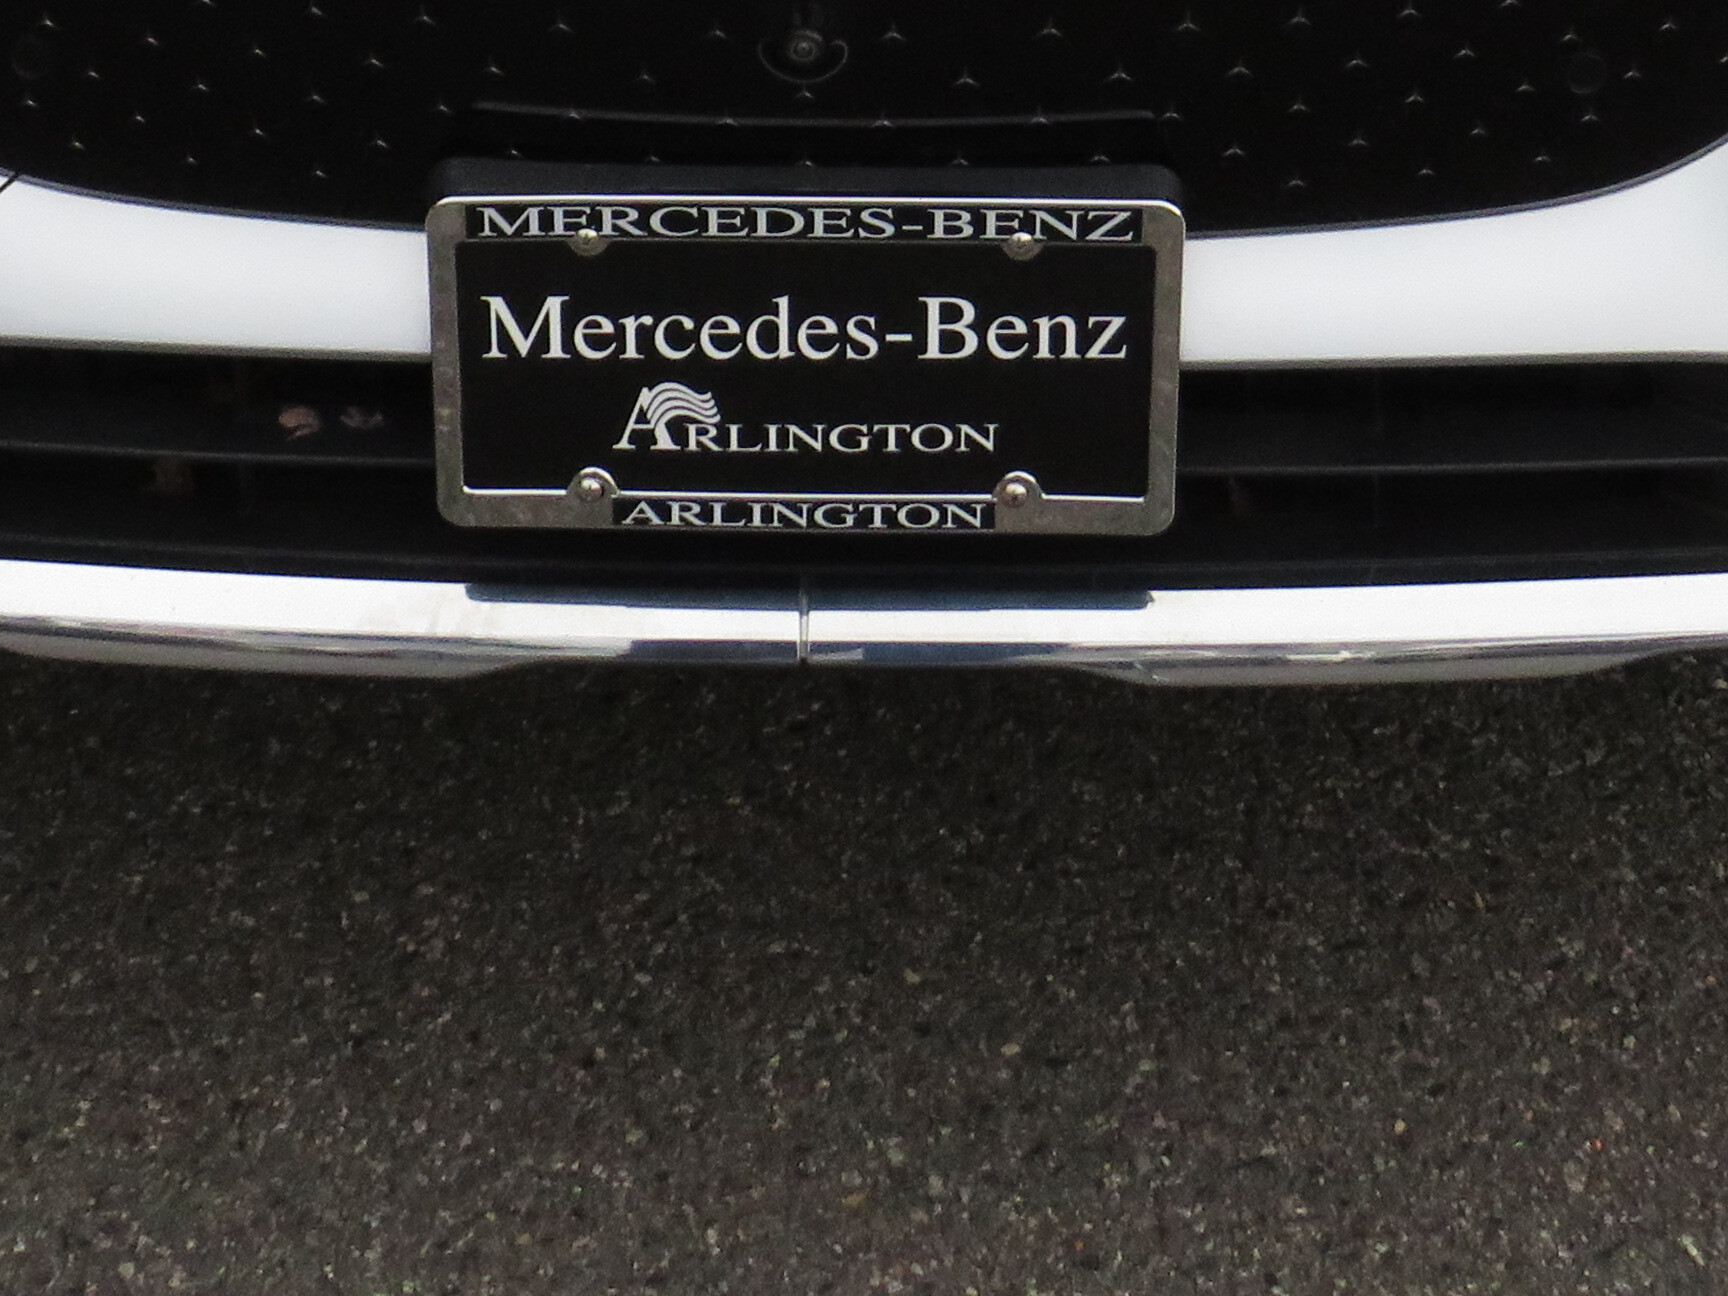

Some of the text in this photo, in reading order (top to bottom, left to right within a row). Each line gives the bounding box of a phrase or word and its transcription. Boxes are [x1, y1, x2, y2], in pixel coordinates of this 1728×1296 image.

[477, 206, 1133, 242] MERCEDES-BENZ
[479, 294, 1127, 361] Mercedes-Benz
[622, 499, 986, 530] ARLINGTON
